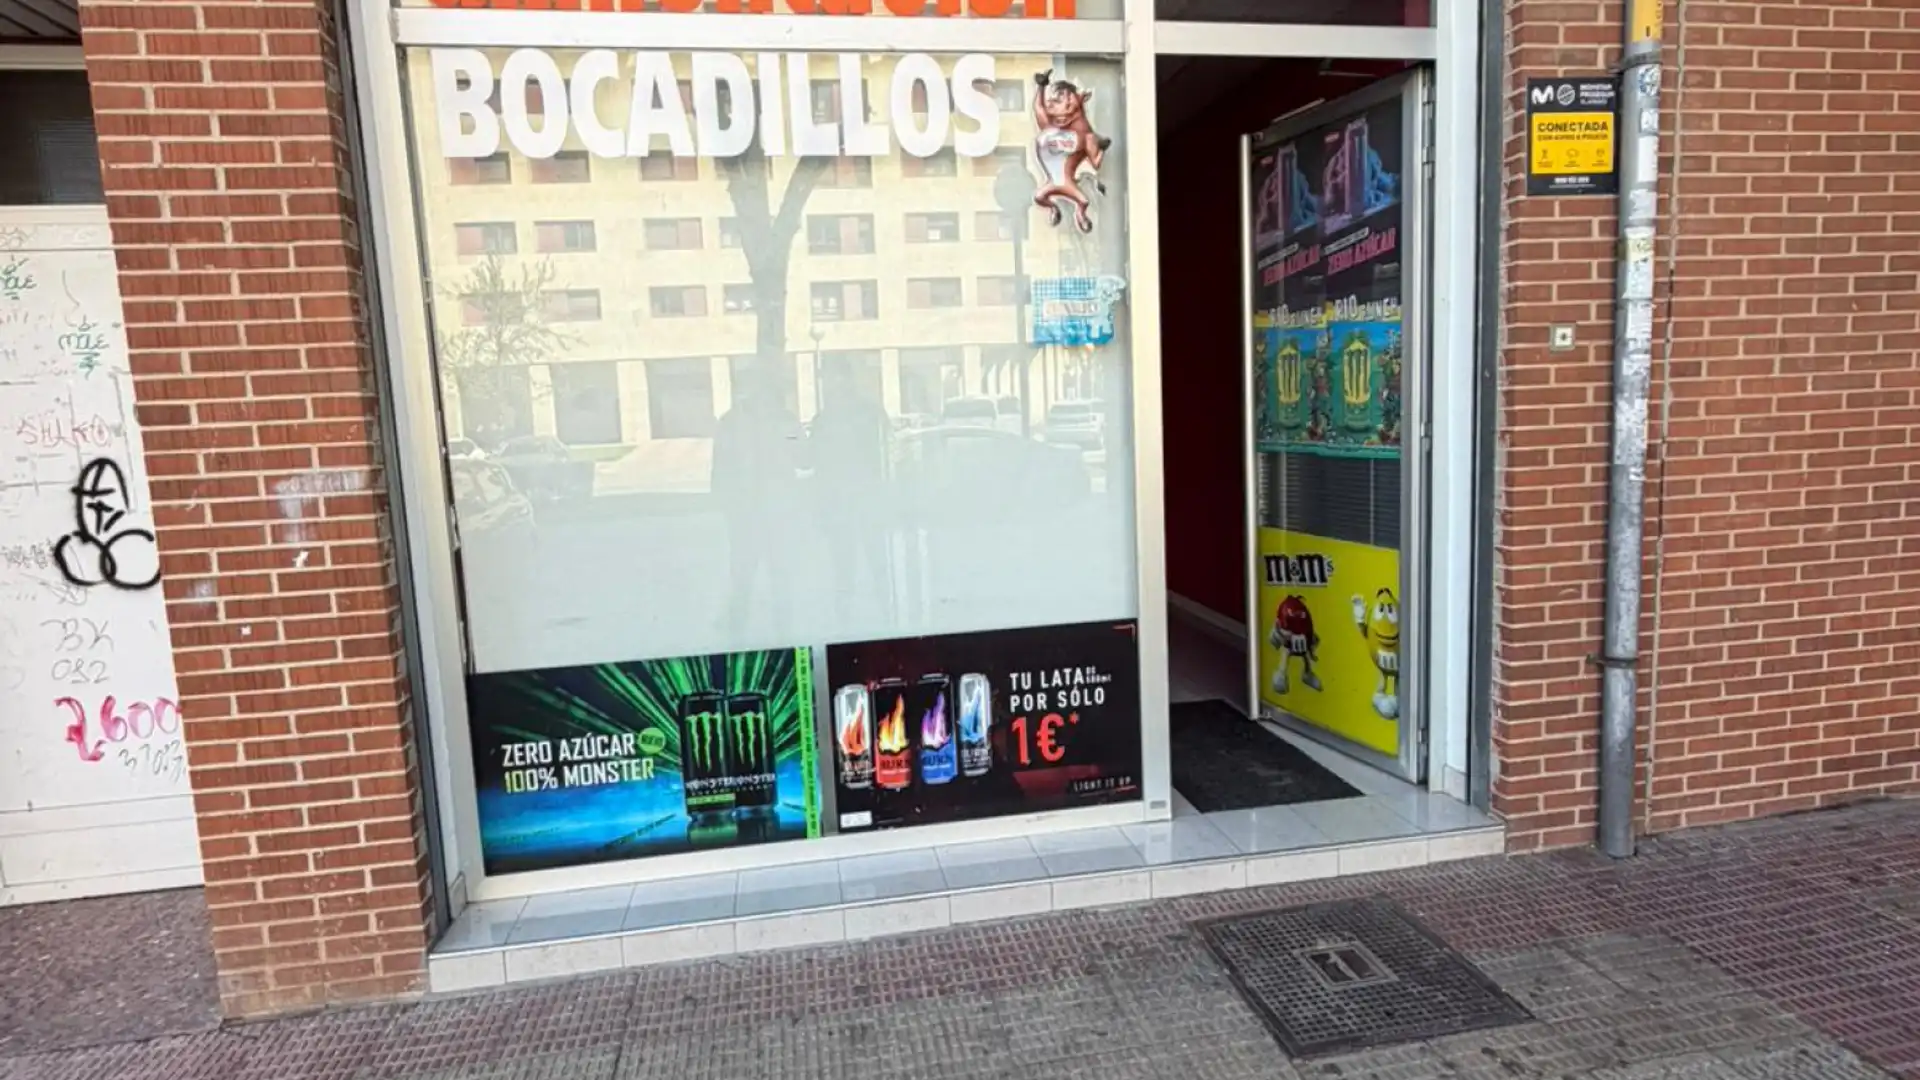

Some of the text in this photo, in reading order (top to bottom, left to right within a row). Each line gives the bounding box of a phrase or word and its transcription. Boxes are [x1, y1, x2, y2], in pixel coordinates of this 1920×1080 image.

[431, 48, 1000, 158] BOCADILLOS
[1537, 121, 1608, 132] CONECTADA
[1009, 671, 1032, 691] TU
[1040, 667, 1085, 689] LATA
[1010, 685, 1105, 713] POR SÓLO
[501, 741, 553, 768] ZERO
[559, 732, 636, 762] AZÚCAR
[504, 757, 655, 795] 100% MONSTER
